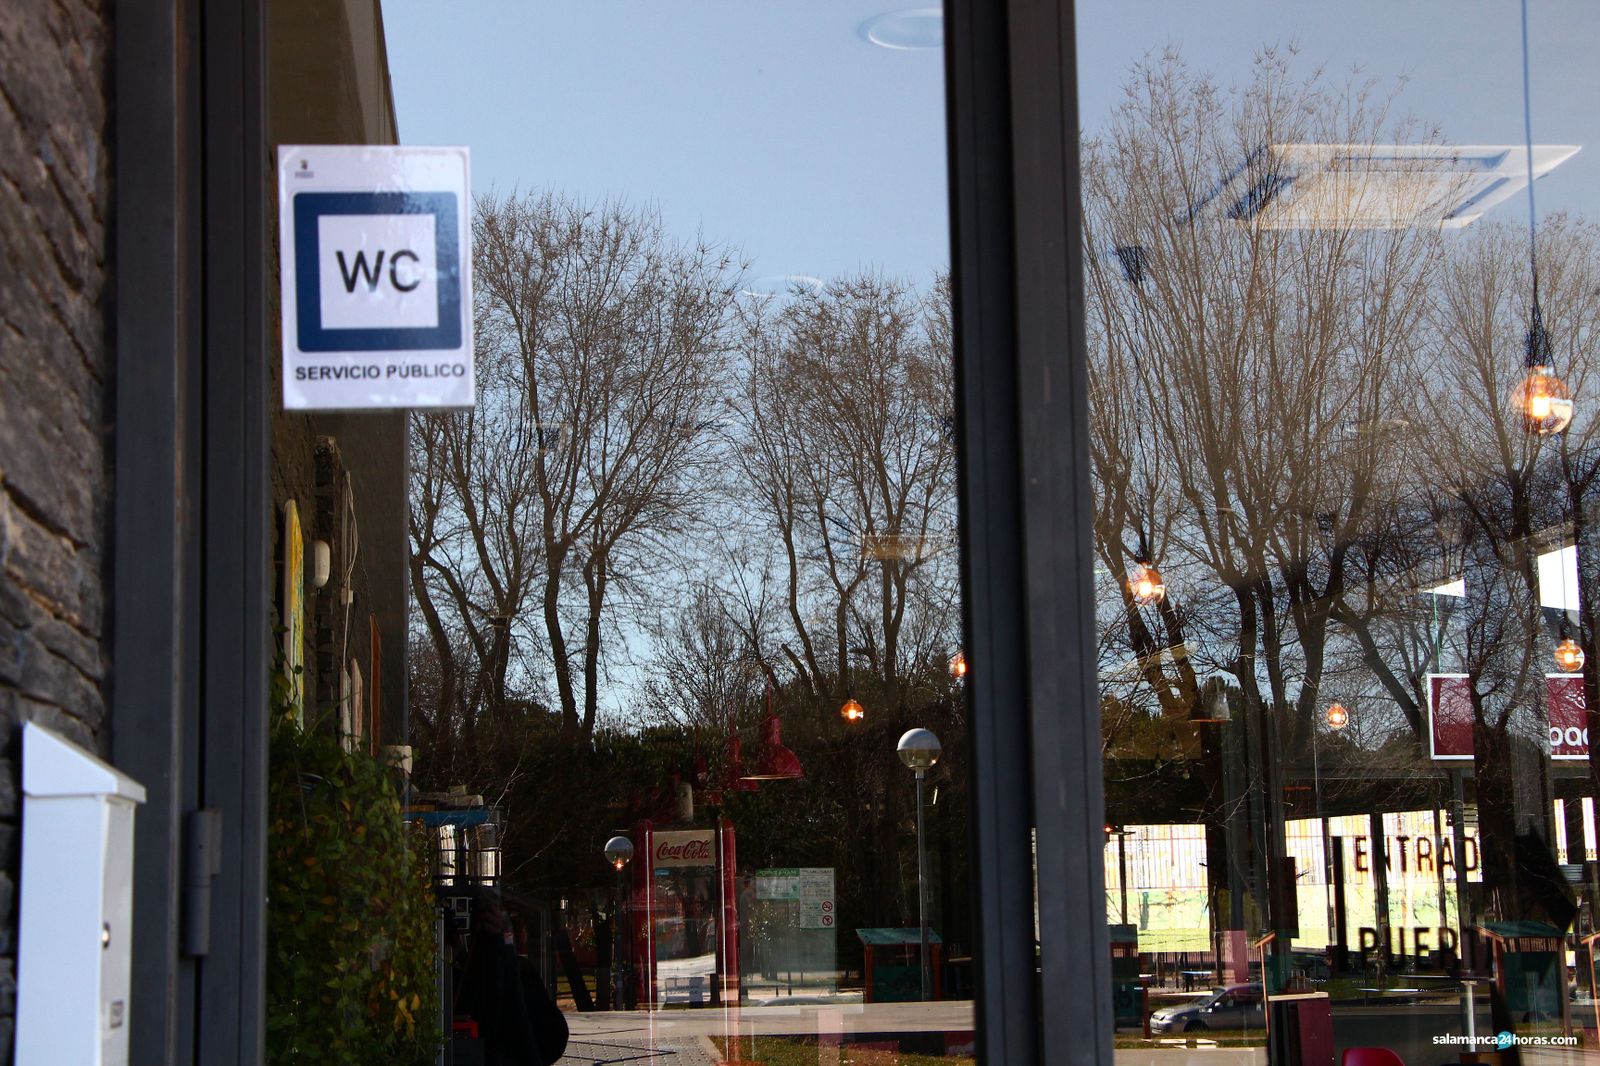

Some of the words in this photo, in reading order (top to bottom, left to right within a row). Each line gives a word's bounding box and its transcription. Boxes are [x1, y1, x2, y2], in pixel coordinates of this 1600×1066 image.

[336, 250, 421, 293] WC
[295, 365, 380, 381] SERVICIO
[386, 361, 465, 379] PÚBLICO
